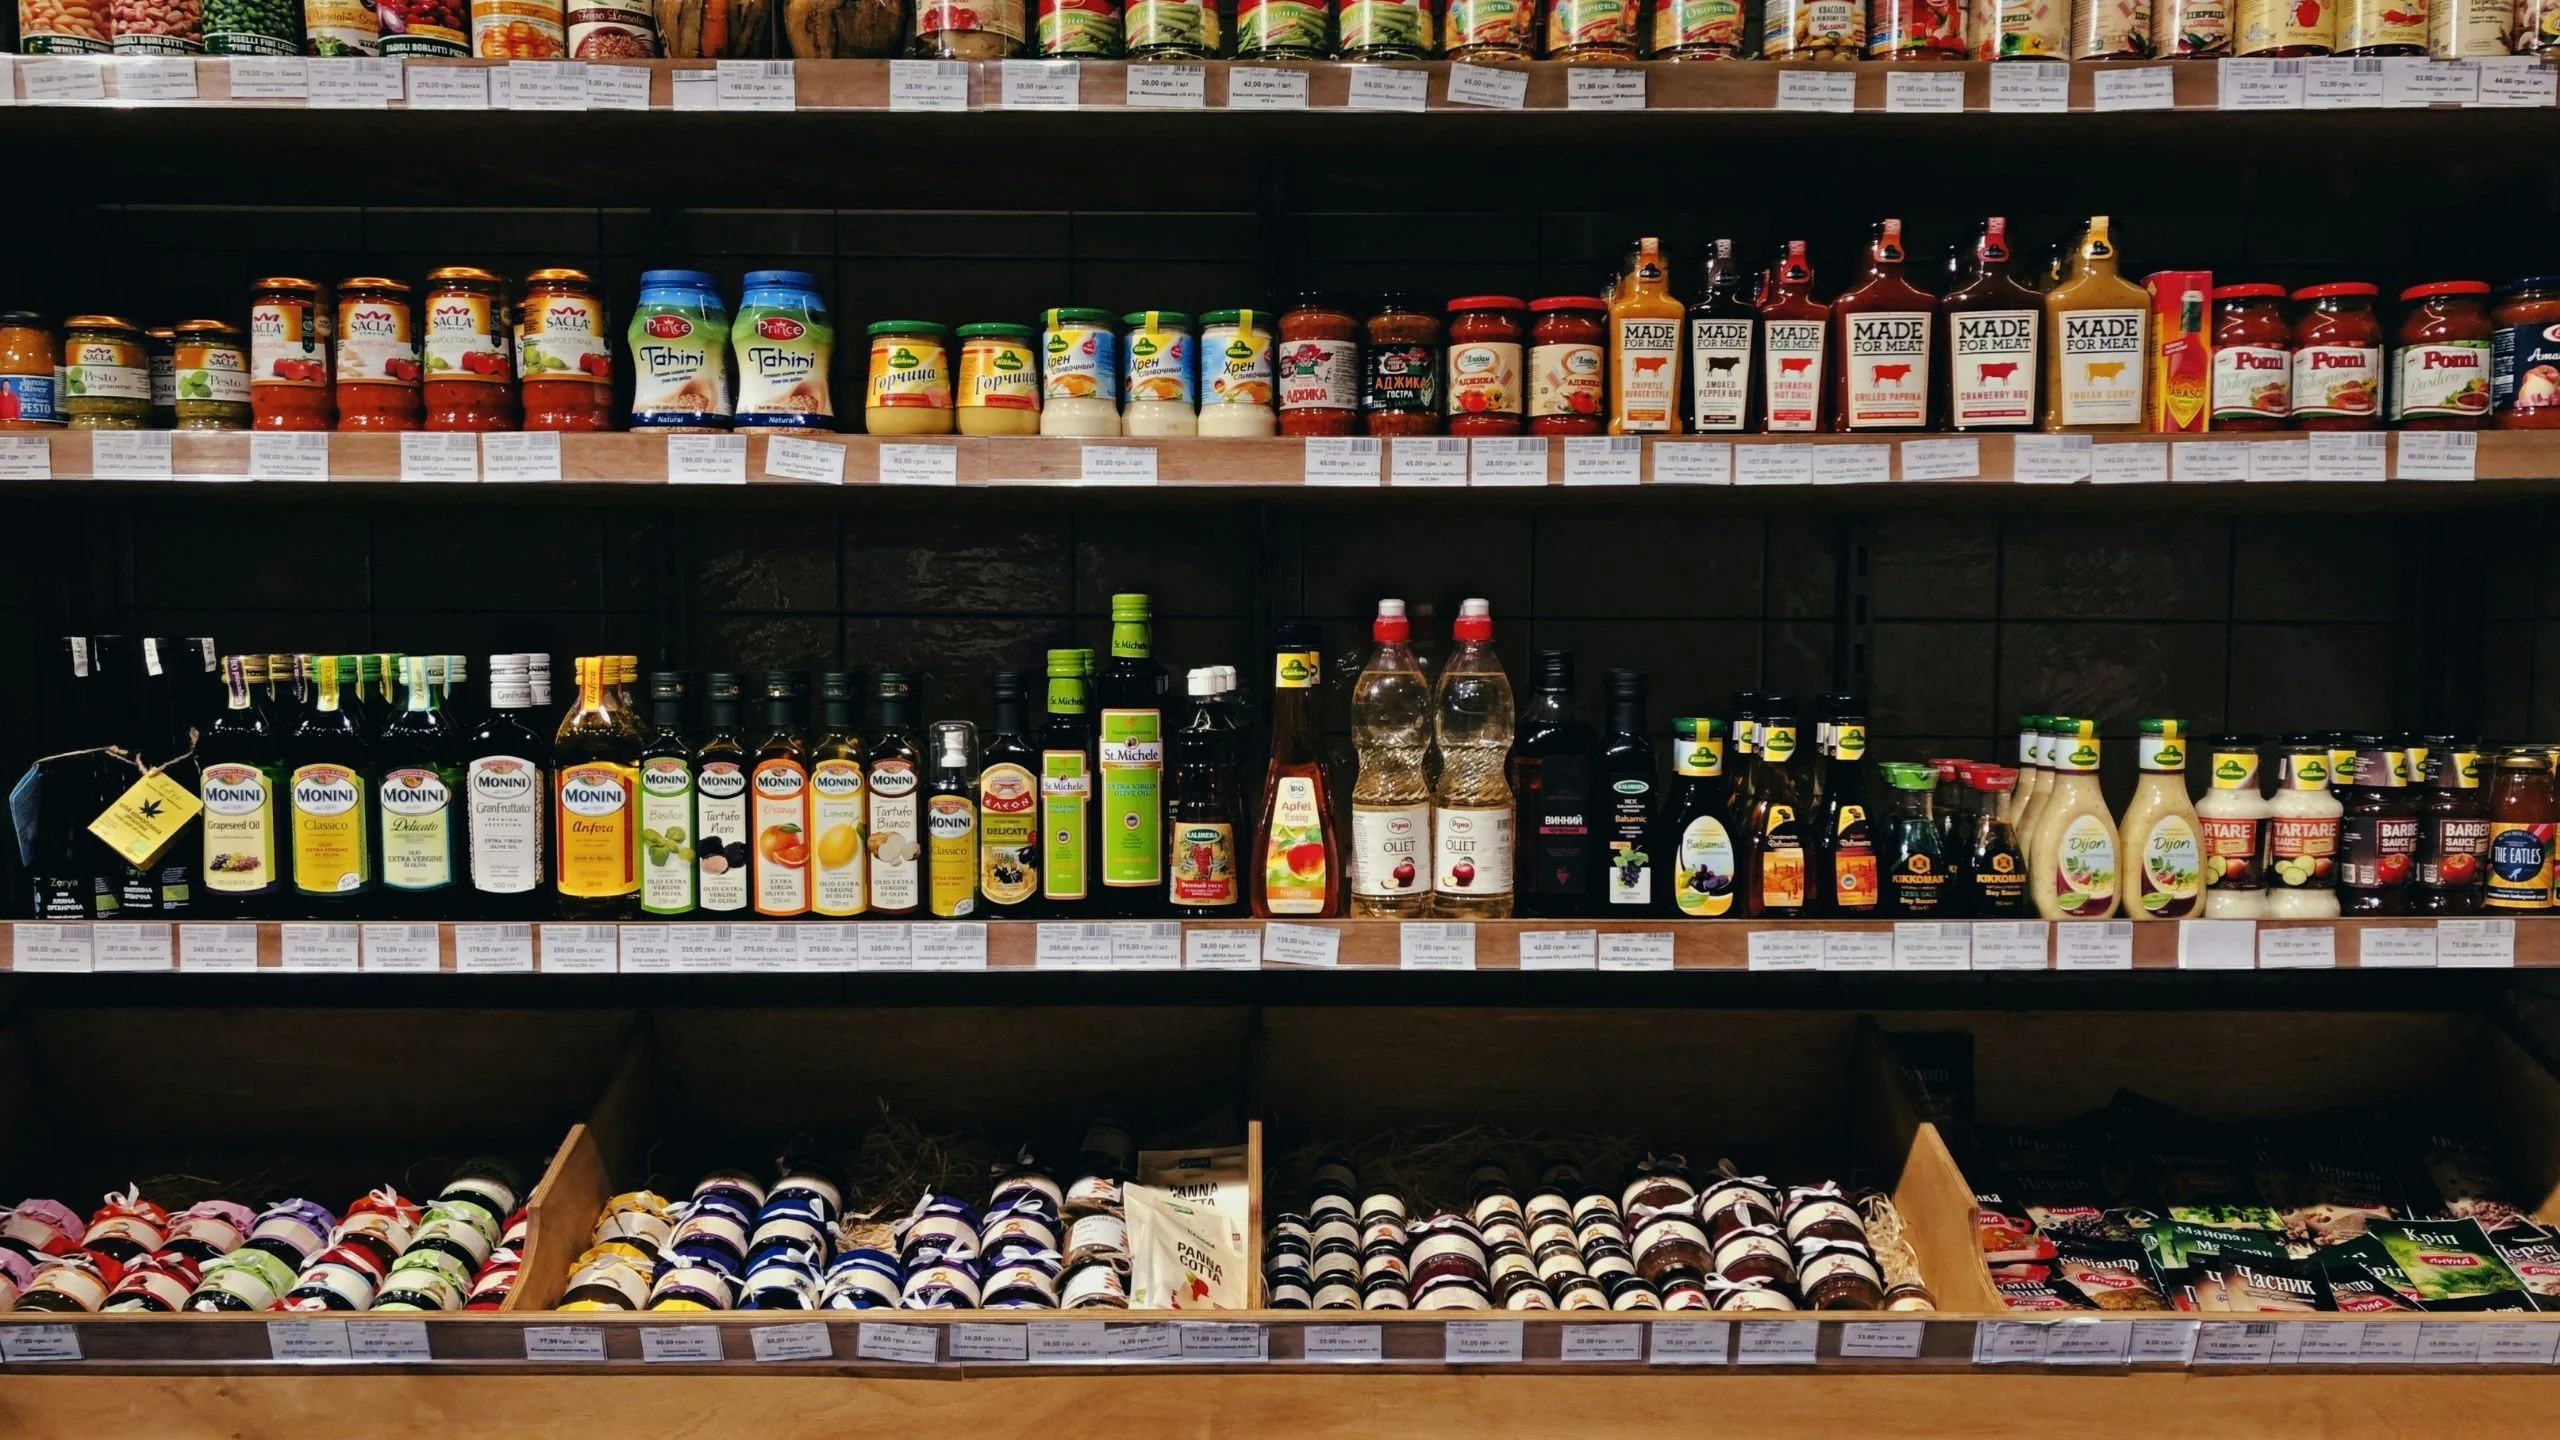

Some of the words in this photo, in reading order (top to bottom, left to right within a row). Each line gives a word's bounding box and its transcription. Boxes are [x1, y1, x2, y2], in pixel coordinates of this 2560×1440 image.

[647, 318, 691, 336] Prince
[758, 319, 802, 336] Prince
[1624, 325, 1675, 340] MADE
[1697, 326, 1748, 340] MADE
[1770, 326, 1820, 341] MADE
[1853, 321, 1923, 341] MADE
[1958, 319, 2031, 339] MADE
[2066, 318, 2138, 339] MADE
[1624, 339, 1644, 348] FOR
[1646, 339, 1676, 348] MEAT
[1697, 339, 1718, 348] FOR
[1720, 339, 1749, 348] MEAT
[1769, 340, 1789, 349] FOR
[1791, 340, 1821, 349] MEAT
[1853, 340, 1882, 353] FOR
[1884, 340, 1925, 352] MEAT
[1958, 339, 1986, 352] FOR
[1988, 338, 2032, 351] MEAT
[2066, 339, 2097, 352] FOR
[2099, 337, 2139, 351] MEAT
[640, 346, 705, 374] Tahini
[748, 347, 815, 375] Tahini
[1046, 354, 1071, 373] Хрен
[1131, 358, 1160, 376] Хрен
[1223, 361, 1255, 376] Хрен
[84, 370, 118, 383] Pesto
[210, 374, 242, 387] Pesto
[872, 368, 937, 396] Горчица
[974, 369, 1038, 396] Горчица
[1375, 376, 1429, 391] АДЖИКА
[1631, 382, 1664, 390] CHIPOTLE
[1705, 381, 1736, 390] SMOKED
[1286, 388, 1328, 402] АДЖИКА
[1386, 390, 1414, 399] ГОСТРА
[1625, 390, 1648, 399] BURGER
[1698, 389, 1727, 399] PEPPER
[1774, 391, 1790, 399] HOT
[1854, 393, 1886, 402] GRILLED
[1889, 392, 1922, 402] PAPRIKA
[1960, 391, 2010, 401] CRANBERRY
[20, 404, 51, 414] PESTO
[657, 415, 684, 424] Natural
[768, 415, 796, 424] Natural
[1104, 748, 1117, 761] St.
[1118, 747, 1159, 761] Michele
[479, 777, 526, 789] MONINI
[645, 774, 687, 786] MONINI
[701, 776, 743, 788] MONINI
[757, 777, 802, 788] MONINI
[817, 776, 858, 787] MONINI
[872, 775, 914, 787] MONINI
[1054, 781, 1084, 791] Michele
[205, 787, 260, 802] MONINI
[297, 788, 353, 802] MONINI
[383, 787, 445, 803] MONINI
[564, 788, 622, 803] MONINI
[475, 801, 531, 815] GranFruttato
[823, 807, 855, 820] Limone
[874, 805, 914, 818] Tartufo
[1281, 800, 1312, 814] Apfel
[649, 809, 685, 822] Basilico
[705, 809, 741, 823] Tartufo
[928, 815, 971, 829] MONINI
[1284, 812, 1309, 825] Essig
[1545, 815, 1583, 826] ВИННИЙ
[1615, 814, 1647, 824] Balsamic
[207, 820, 247, 833] Grapeseed
[248, 819, 261, 831] Oil
[304, 819, 348, 831] Classico
[391, 818, 439, 832] Delicato
[572, 821, 614, 834] Anfora
[711, 823, 735, 834] Nero
[876, 817, 911, 830] Bianco
[2204, 822, 2251, 838] RTARE
[2275, 822, 2336, 838] TARTARE
[2381, 823, 2418, 838] BARBE
[986, 827, 1029, 836] DELICATE
[1383, 839, 1416, 853] ОЦЕТ
[1445, 839, 1477, 853] ОЦЕТ
[1686, 836, 1726, 851] Balsamic
[2069, 835, 2106, 852] Dijon
[2154, 835, 2190, 852] Dijon
[2274, 838, 2301, 848] SAUCE
[2381, 838, 2409, 848] SAUCE
[2445, 838, 2475, 848] SAUCE
[2494, 846, 2507, 864] THE
[2509, 845, 2542, 865] EATLES
[2401, 1226, 2460, 1247] Кріп
[1176, 1240, 1224, 1278] PANNA
[1178, 1254, 1223, 1287] COTTA
[2234, 1263, 2317, 1296] Часник
